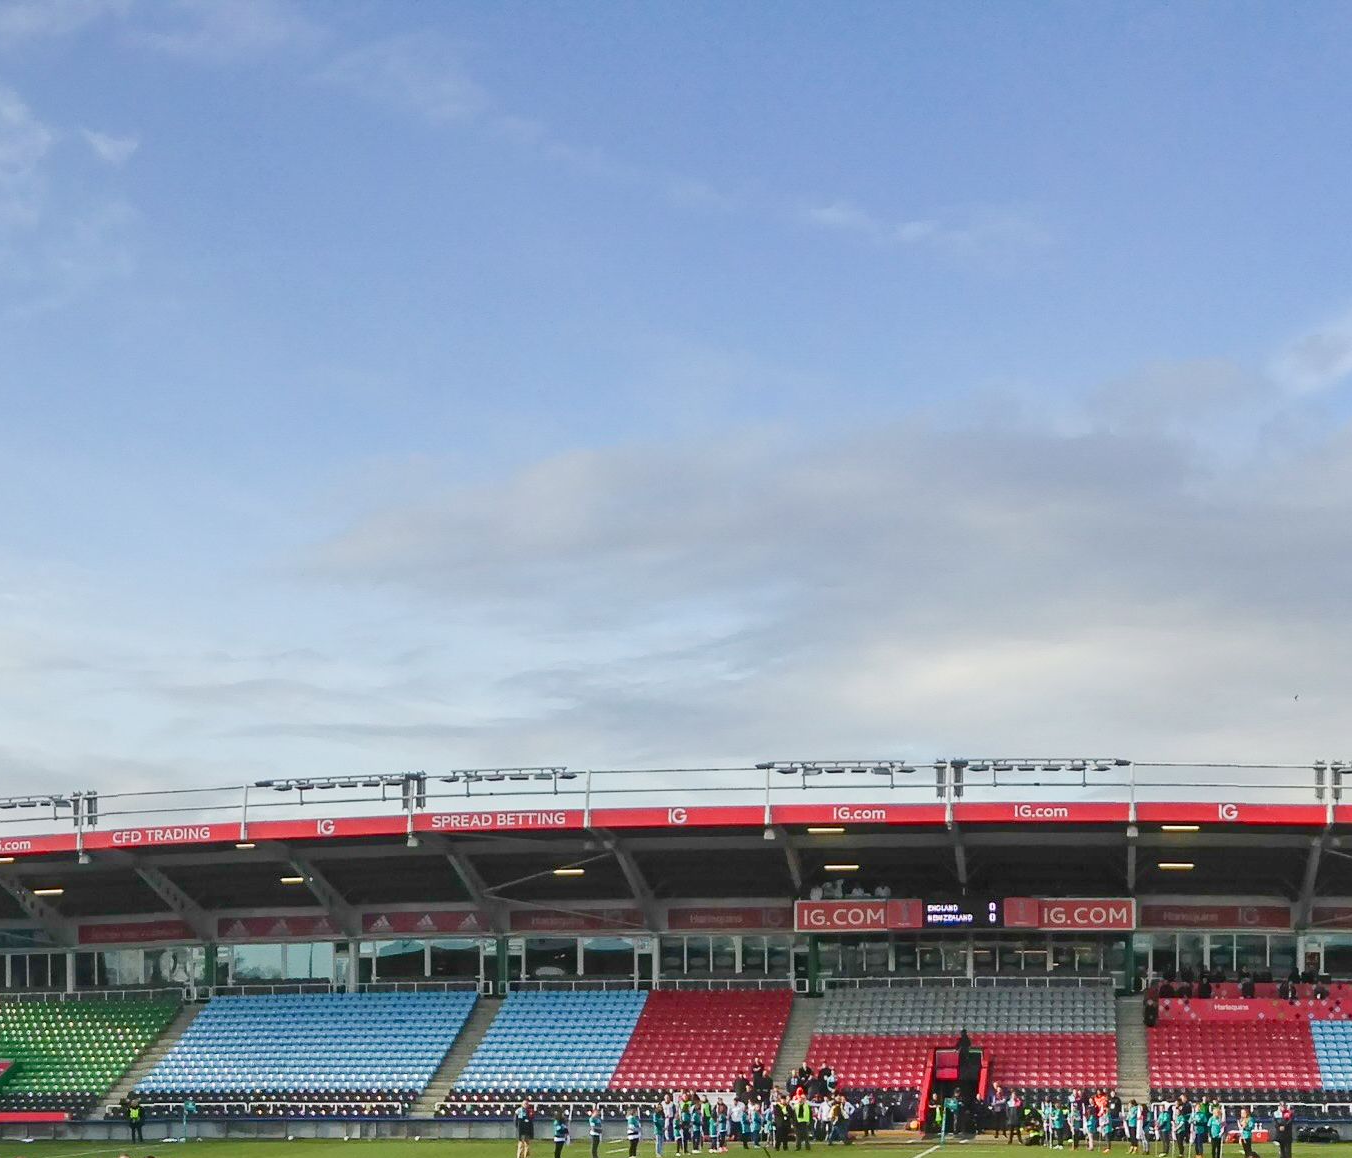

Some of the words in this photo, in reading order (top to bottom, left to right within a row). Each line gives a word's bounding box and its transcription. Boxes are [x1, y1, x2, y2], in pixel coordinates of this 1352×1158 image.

[431, 813, 493, 828] SPREAD
[496, 811, 566, 827] BETTING
[668, 808, 688, 825] IG
[833, 806, 886, 821] IG.com
[1014, 804, 1068, 818] IG.com
[1218, 803, 1238, 821] IG
[112, 830, 142, 843] CFD
[145, 826, 210, 841] TRADING
[316, 819, 335, 835] IG
[927, 904, 959, 912] ENGLAND
[1044, 906, 1127, 924] IG.COM
[804, 908, 884, 926] IG.COM
